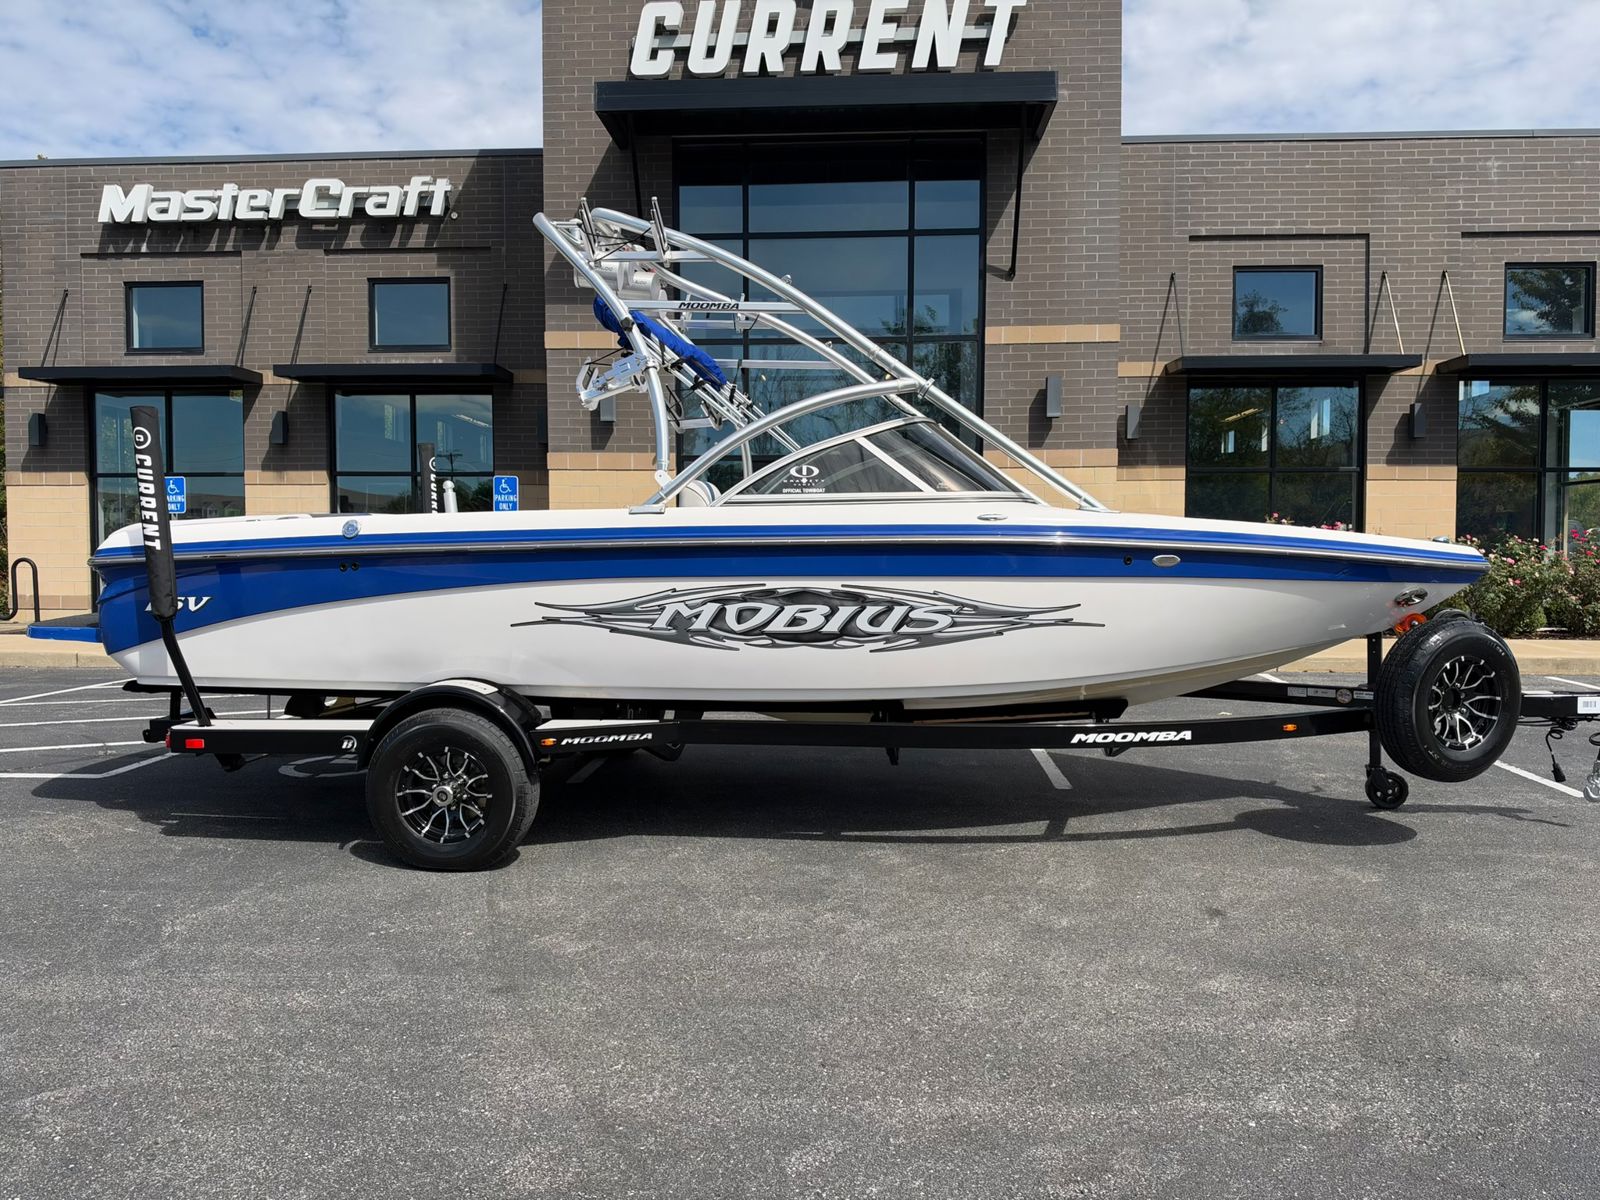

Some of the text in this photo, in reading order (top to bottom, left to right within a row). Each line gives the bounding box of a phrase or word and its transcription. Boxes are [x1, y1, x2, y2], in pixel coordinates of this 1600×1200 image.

[630, 0, 1027, 77] CURRENT
[98, 175, 452, 224] MasterCraft
[679, 302, 740, 310] MOOMBA
[135, 453, 162, 551] CURRENT
[495, 494, 517, 502] PARKING
[499, 502, 513, 510] ONLY
[649, 602, 962, 634] MOBIUS
[560, 732, 653, 746] MOOMBA
[1070, 730, 1192, 744] MOOMBA
